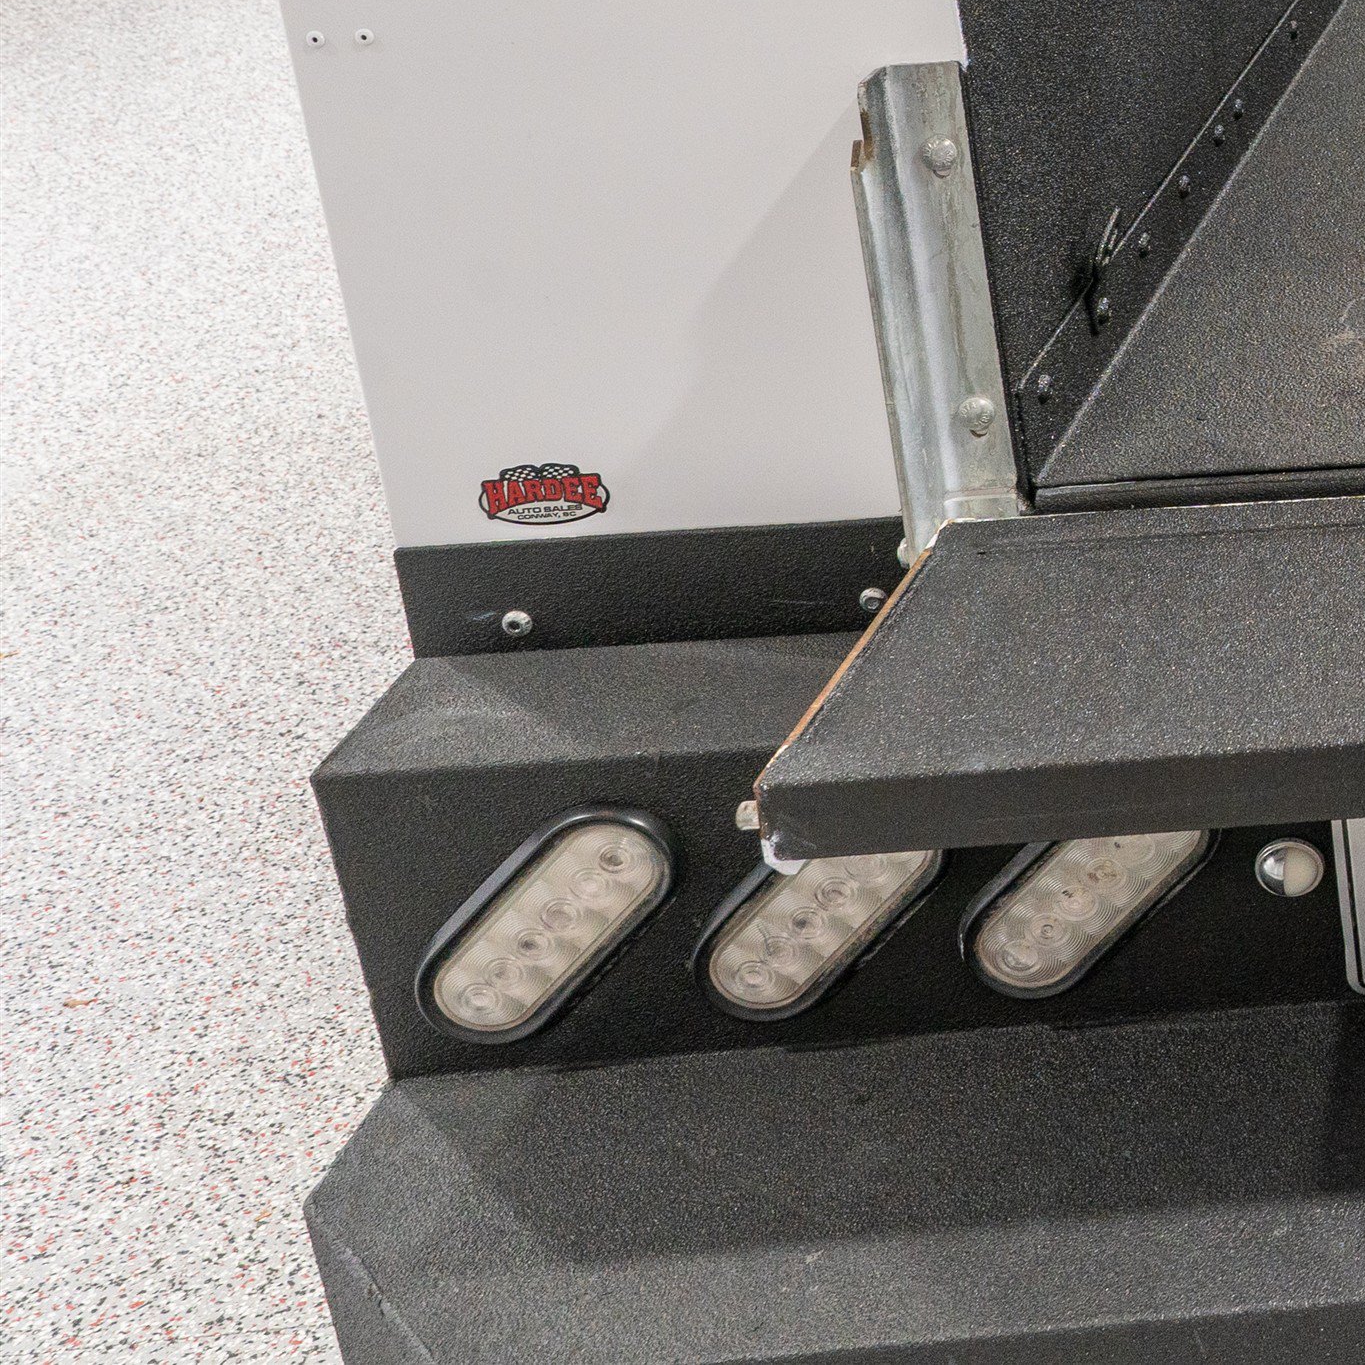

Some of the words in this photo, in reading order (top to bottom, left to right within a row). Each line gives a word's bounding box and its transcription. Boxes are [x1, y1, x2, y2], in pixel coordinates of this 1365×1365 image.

[481, 475, 604, 516] HARDEE
[508, 506, 542, 515] AUTO
[544, 503, 583, 513] SALES
[517, 512, 561, 520] CONWAY,
